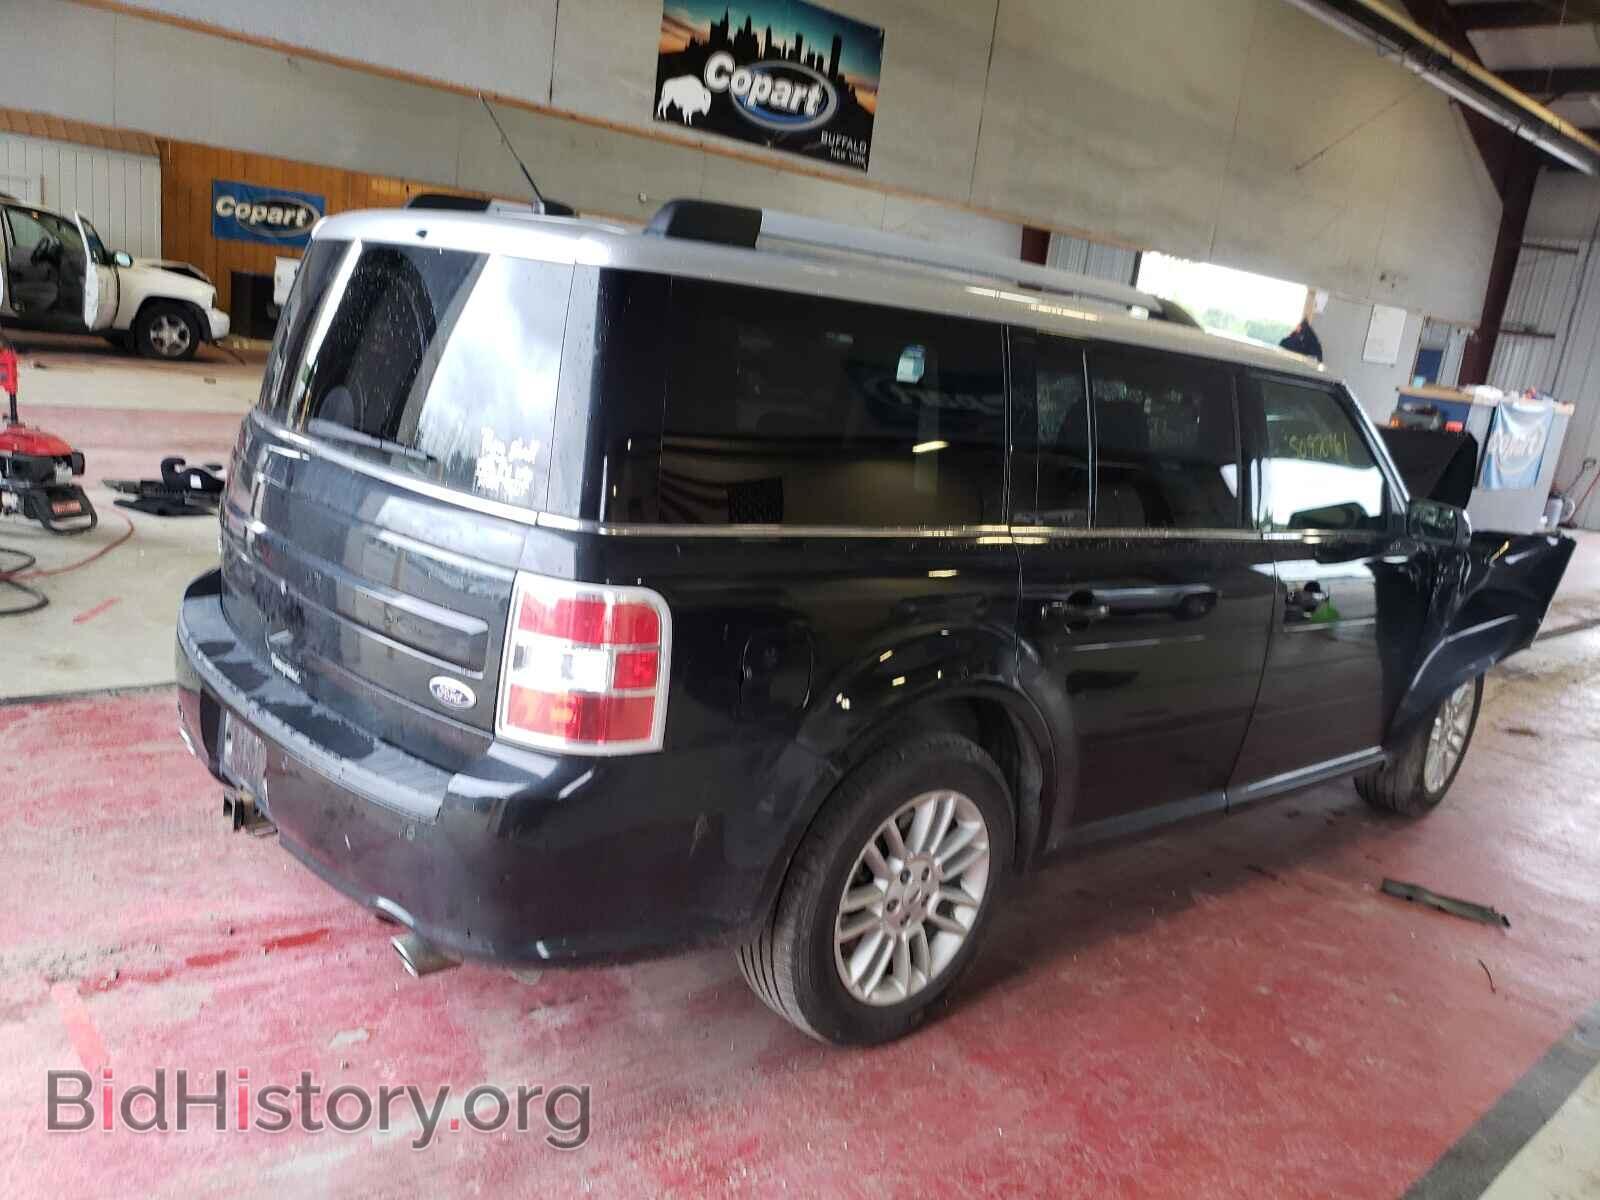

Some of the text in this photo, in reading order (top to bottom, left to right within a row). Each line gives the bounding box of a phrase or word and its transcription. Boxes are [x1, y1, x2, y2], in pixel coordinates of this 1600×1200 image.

[704, 52, 824, 117] Copart
[821, 130, 867, 153] BUFFALO
[216, 195, 308, 228] Copart
